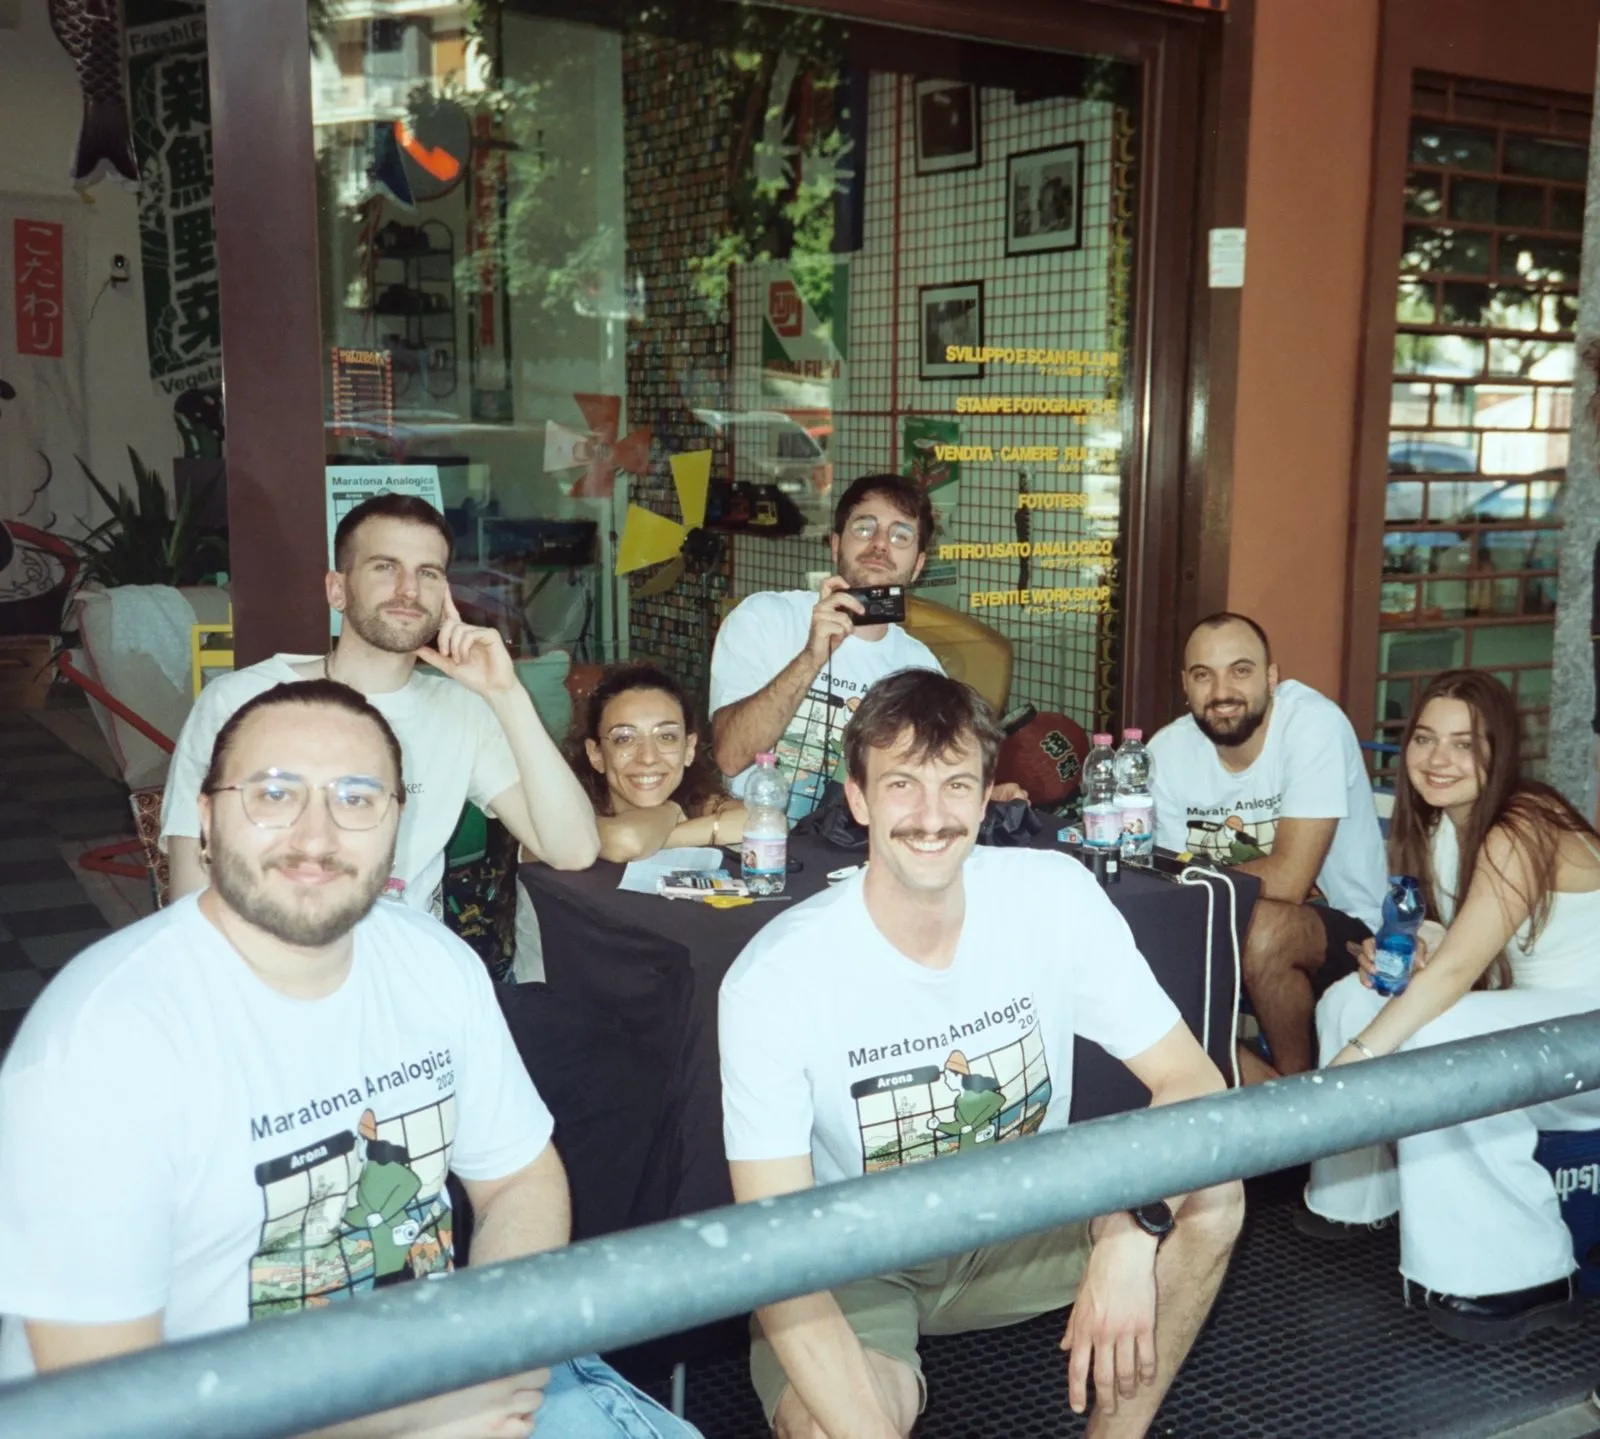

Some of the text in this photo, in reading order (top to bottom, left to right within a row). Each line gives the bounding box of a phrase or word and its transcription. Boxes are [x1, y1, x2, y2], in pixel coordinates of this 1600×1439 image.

[1027, 349, 1067, 366] SCAN
[956, 397, 1117, 414] STAMPE FOTOGRAFICHE
[935, 445, 993, 461] VENDITA
[1000, 446, 1058, 461] CAMERE
[1018, 493, 1091, 509] FOTOTESS
[939, 540, 1112, 560] RITIRO USATO ANALOGICO
[970, 587, 1110, 608] EVENTI E WORKSHOP
[404, 783, 425, 794] ker.
[848, 996, 1033, 1068] Maratona Analogic
[877, 1072, 913, 1088] Arona
[249, 1048, 452, 1142] Maratona Analogica
[290, 1145, 328, 1169] Arona
